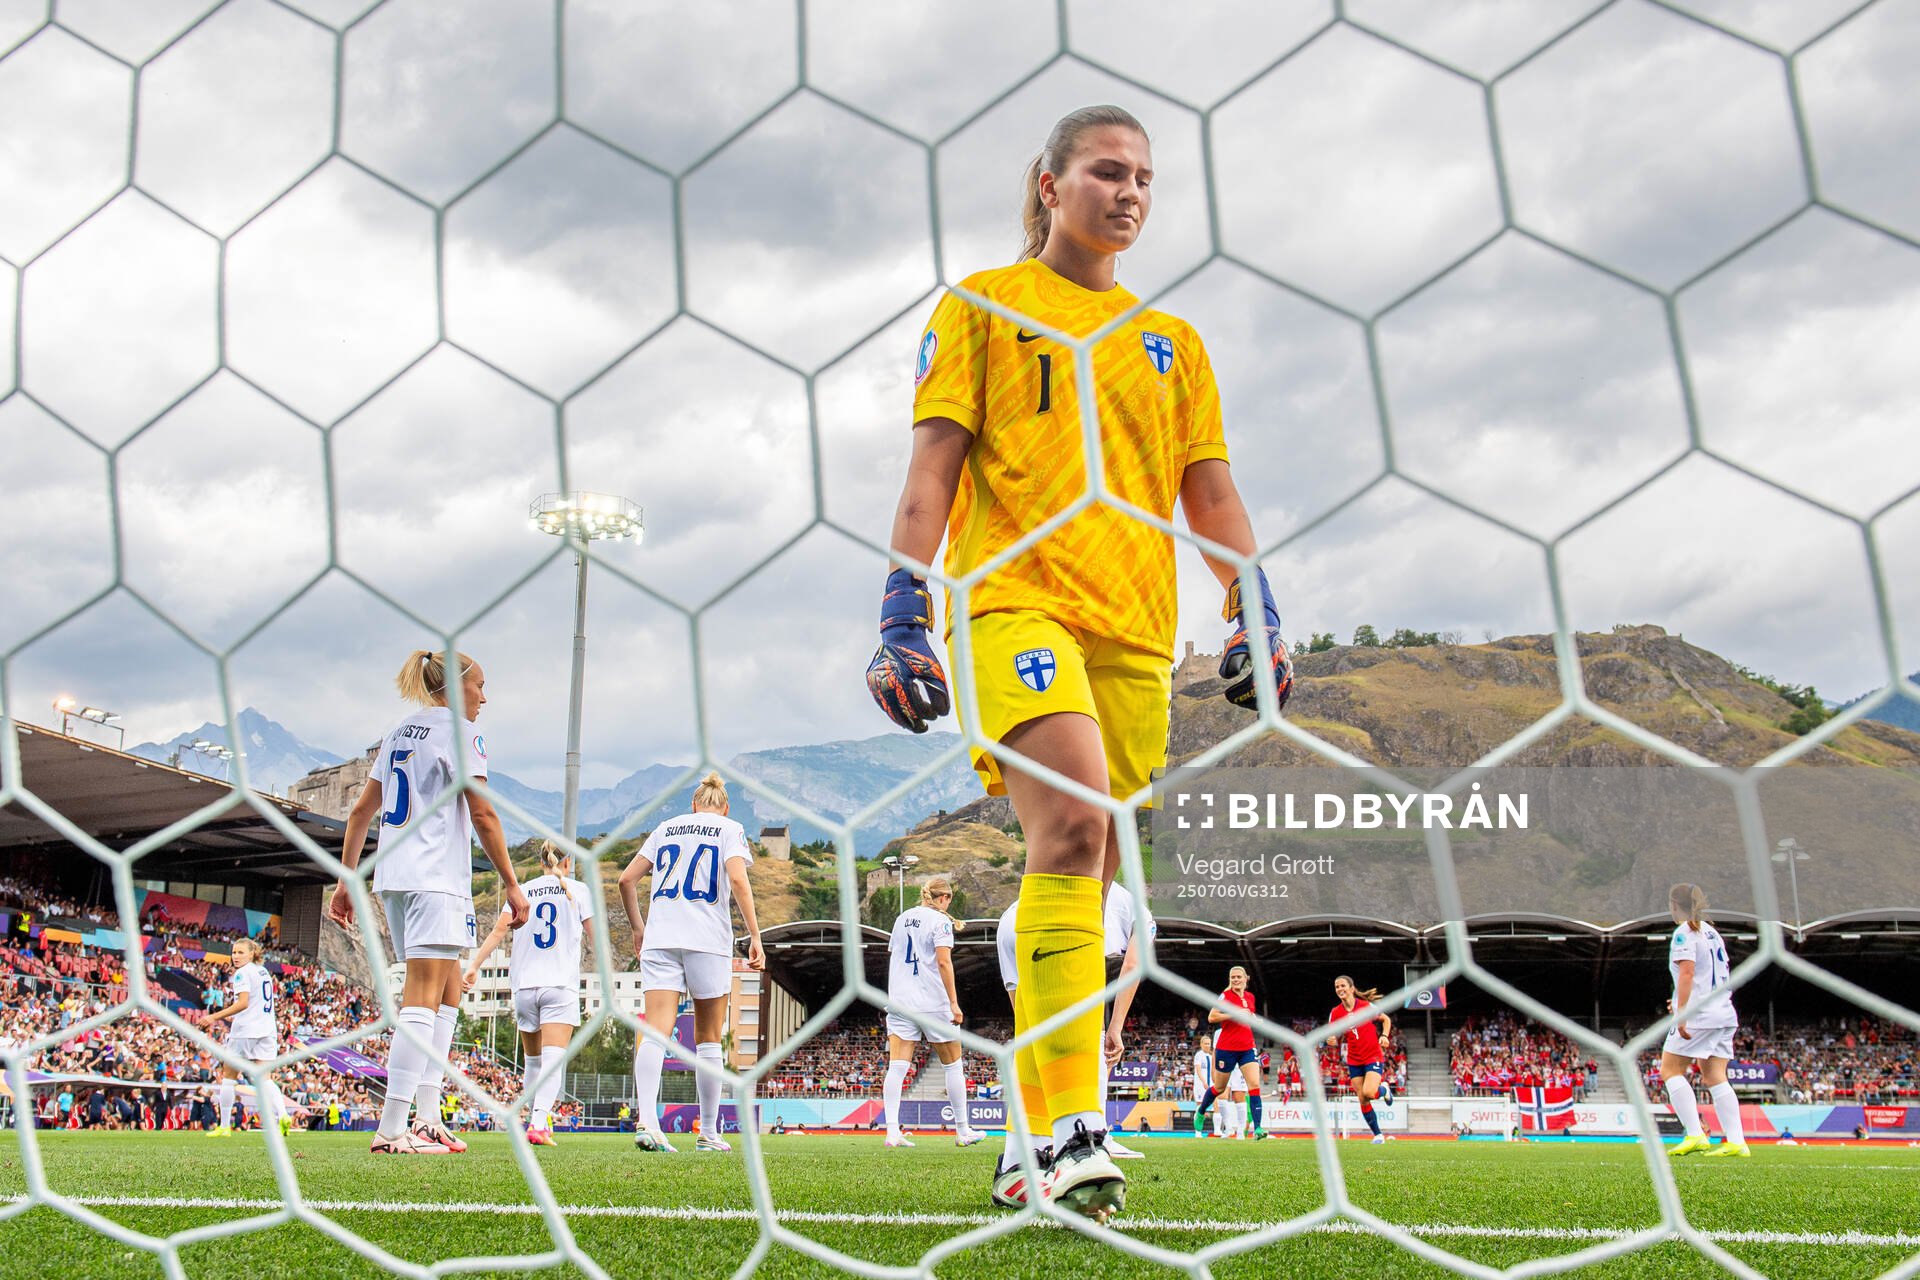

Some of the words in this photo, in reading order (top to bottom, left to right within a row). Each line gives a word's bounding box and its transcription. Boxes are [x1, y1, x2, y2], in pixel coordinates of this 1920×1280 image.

[1037, 353, 1051, 414] 1
[381, 749, 415, 829] 5
[665, 824, 721, 837] SUMMANEN
[652, 843, 720, 905] 20
[533, 901, 558, 950] 3
[904, 932, 920, 976] 4
[262, 980, 273, 1013] 9
[1114, 1066, 1148, 1077] B2-B3
[1727, 1068, 1766, 1079] B3-B4
[971, 1107, 1003, 1120] SION
[1268, 1109, 1300, 1121] UEFA
